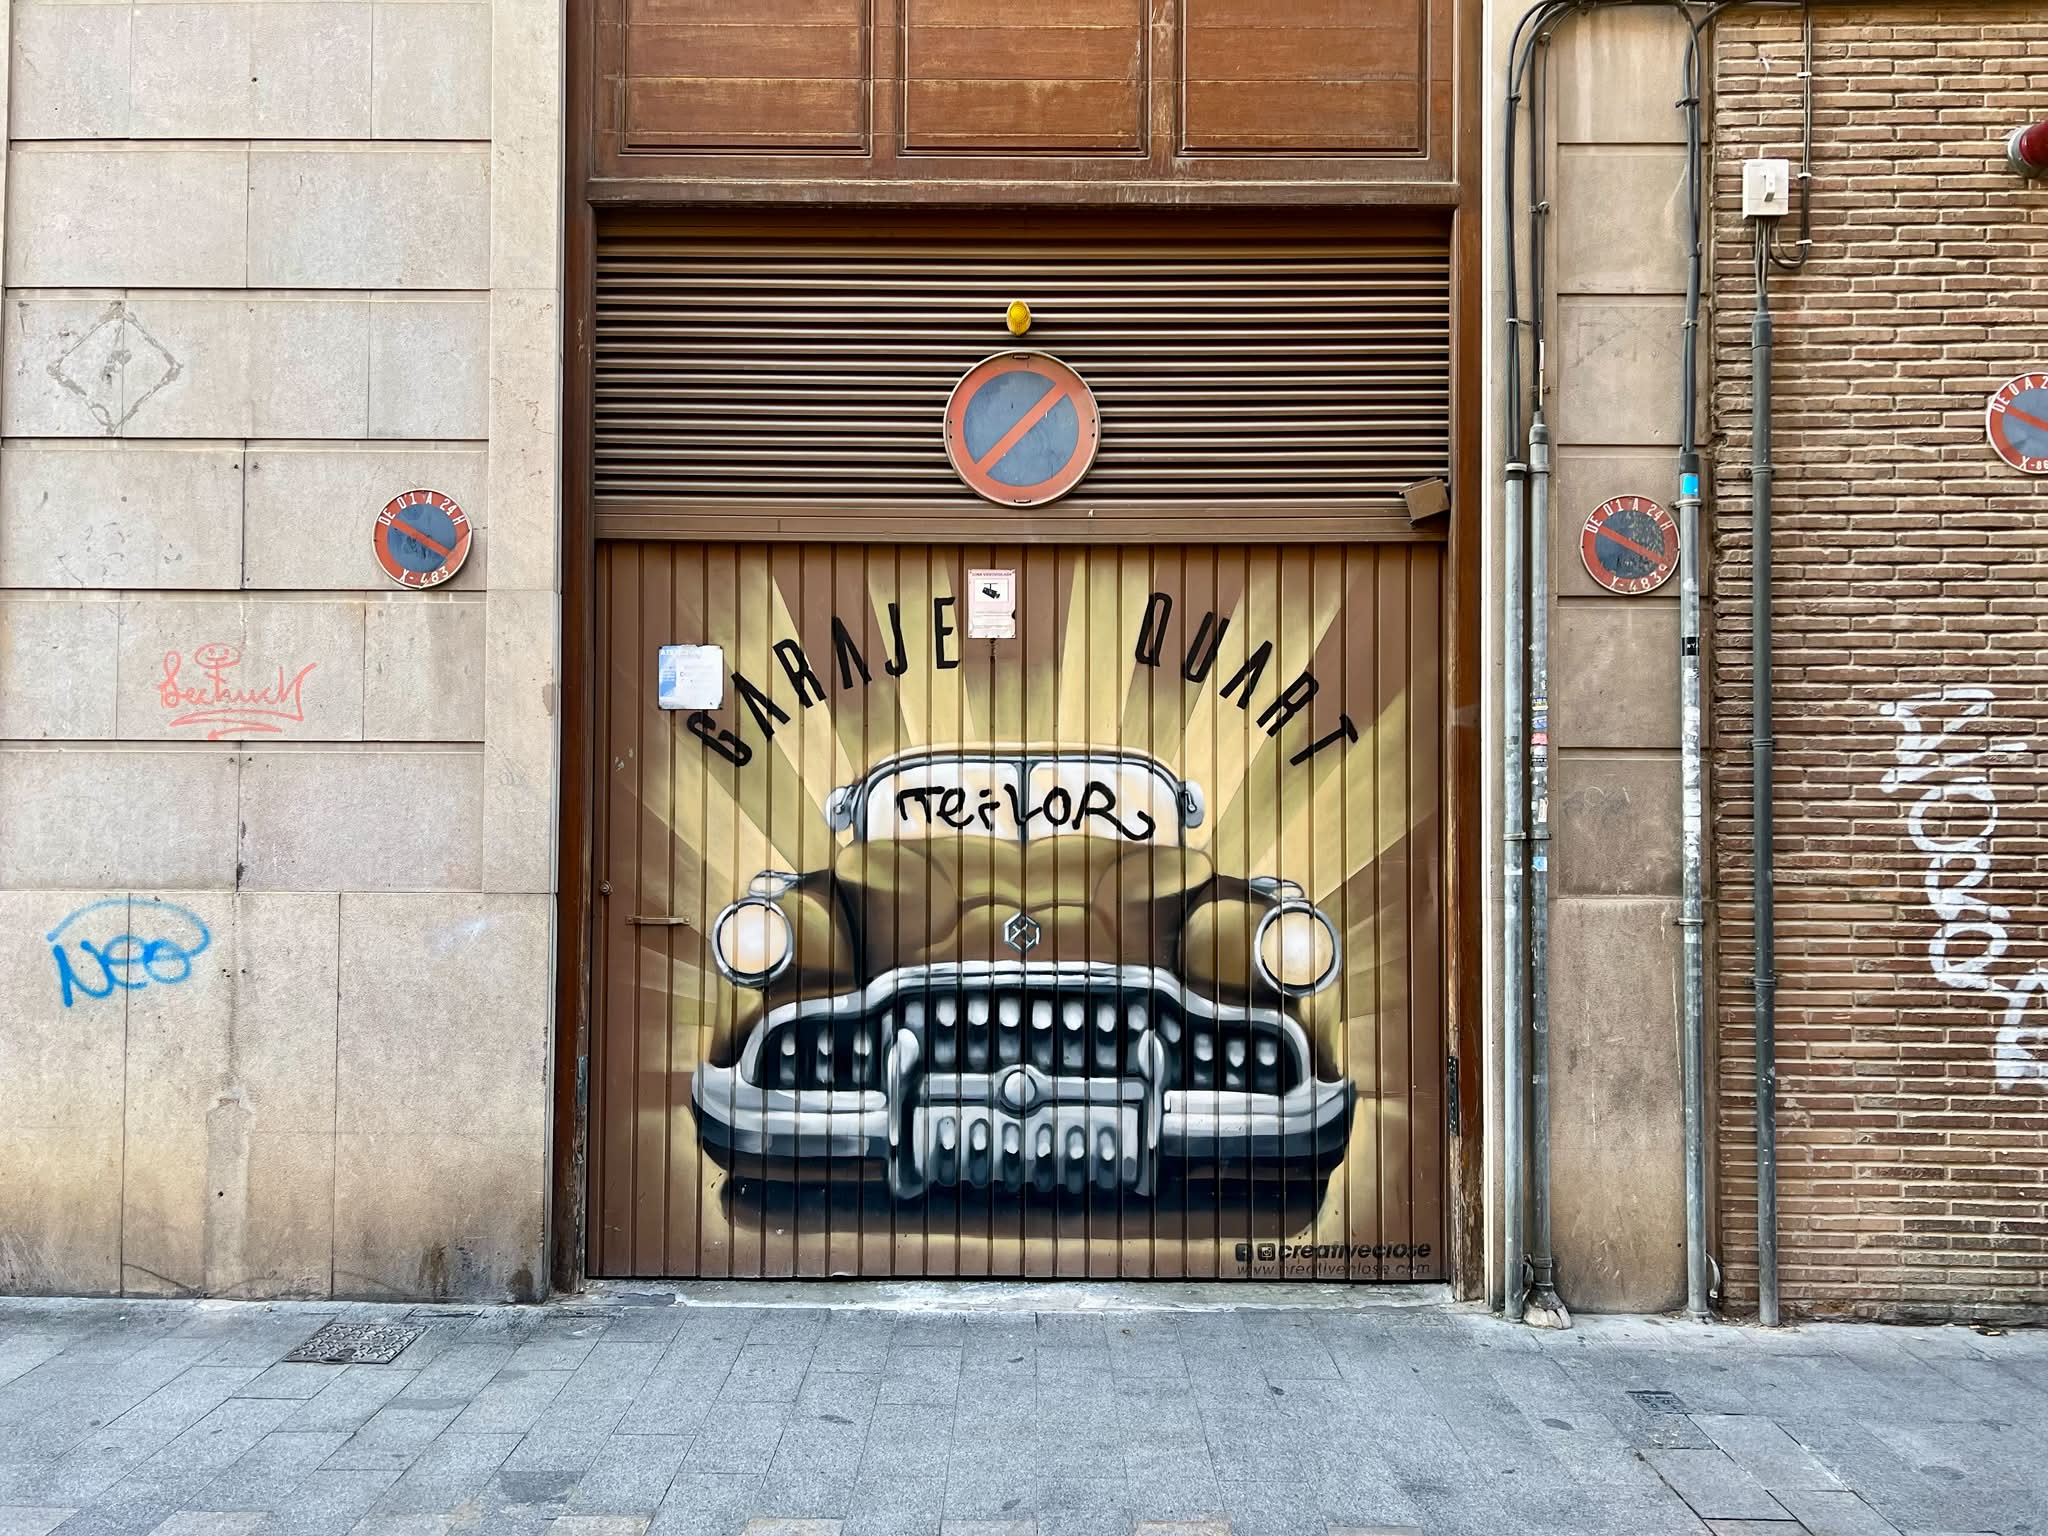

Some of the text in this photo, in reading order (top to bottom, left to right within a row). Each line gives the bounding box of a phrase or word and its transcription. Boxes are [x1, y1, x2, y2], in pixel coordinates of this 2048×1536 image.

[1990, 393, 2010, 413] DE
[2024, 376, 2034, 391] A
[378, 508, 396, 526] DE
[425, 492, 433, 505] A
[1584, 515, 1603, 534] DE
[1632, 497, 1639, 511] A
[687, 592, 1359, 767] GARAJE QUART
